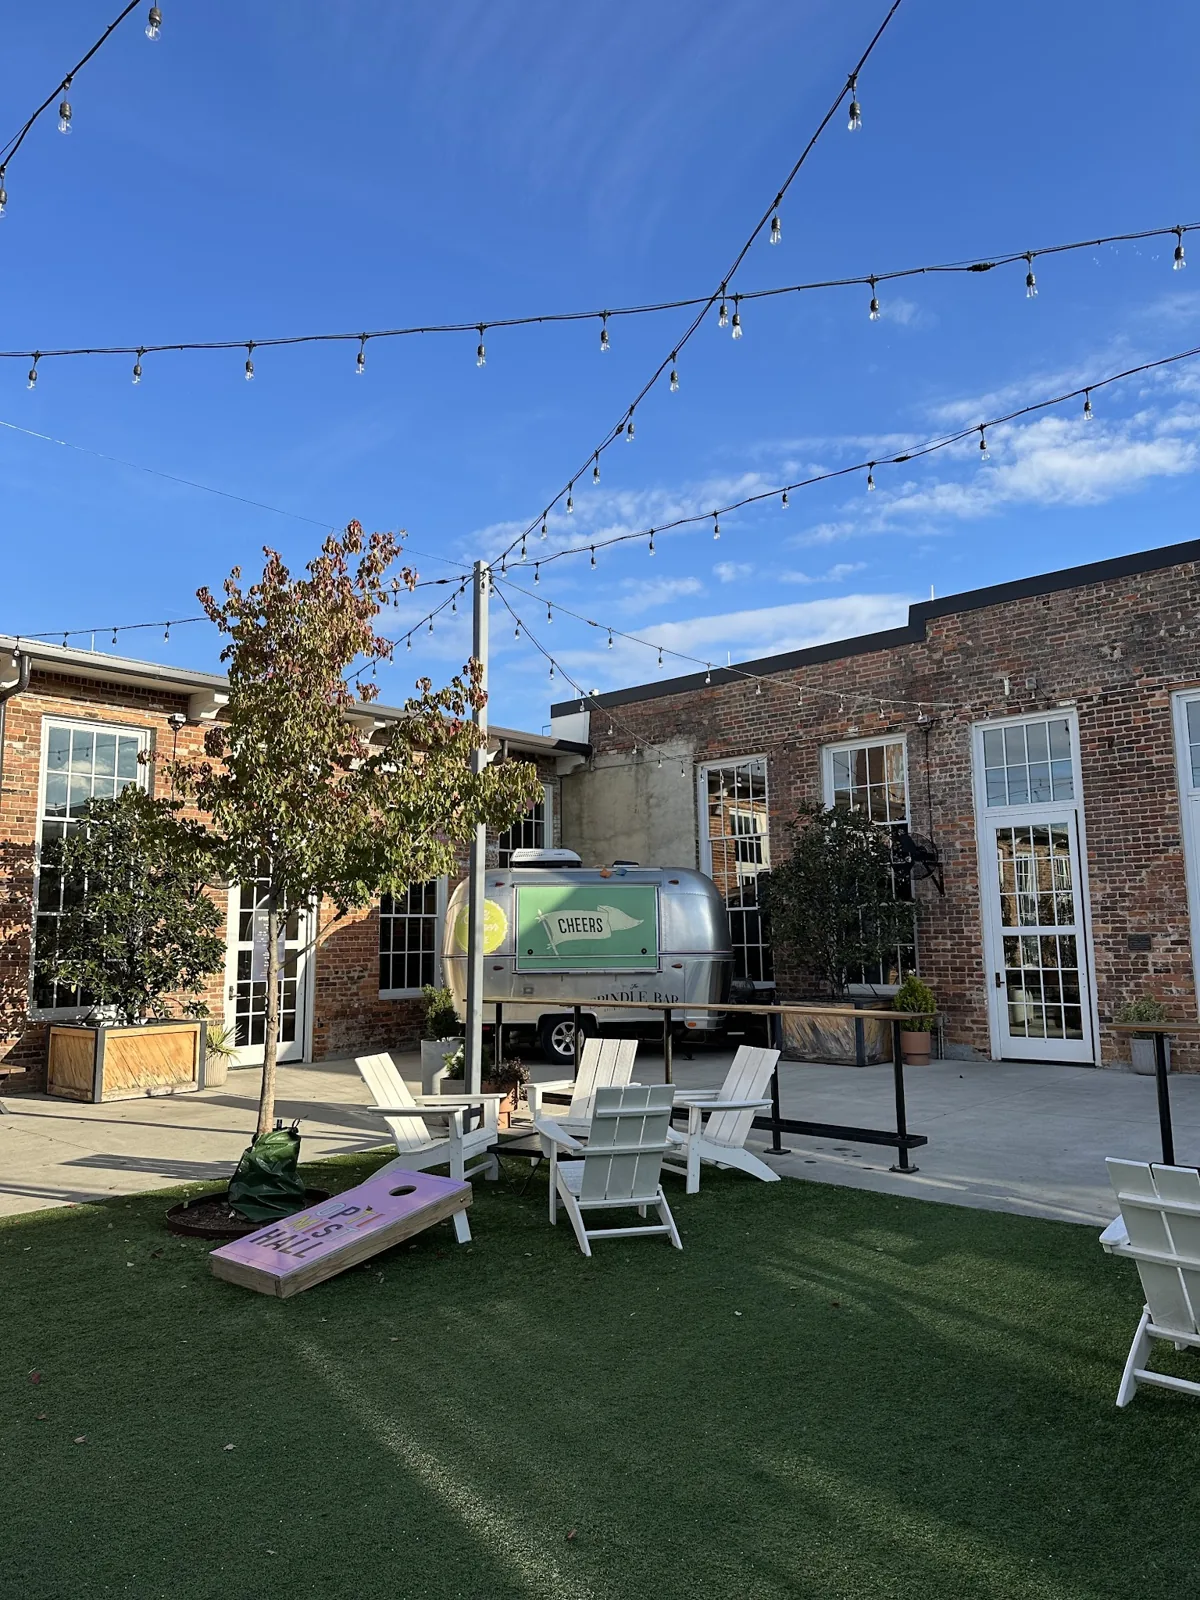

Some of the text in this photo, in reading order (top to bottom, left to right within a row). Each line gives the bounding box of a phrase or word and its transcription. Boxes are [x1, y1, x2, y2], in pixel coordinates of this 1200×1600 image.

[557, 916, 603, 934] CHEERS
[590, 991, 679, 1008] PINDLE BAR
[315, 1202, 386, 1228] OPTI
[283, 1215, 360, 1242] MIST
[249, 1228, 324, 1259] HALL
